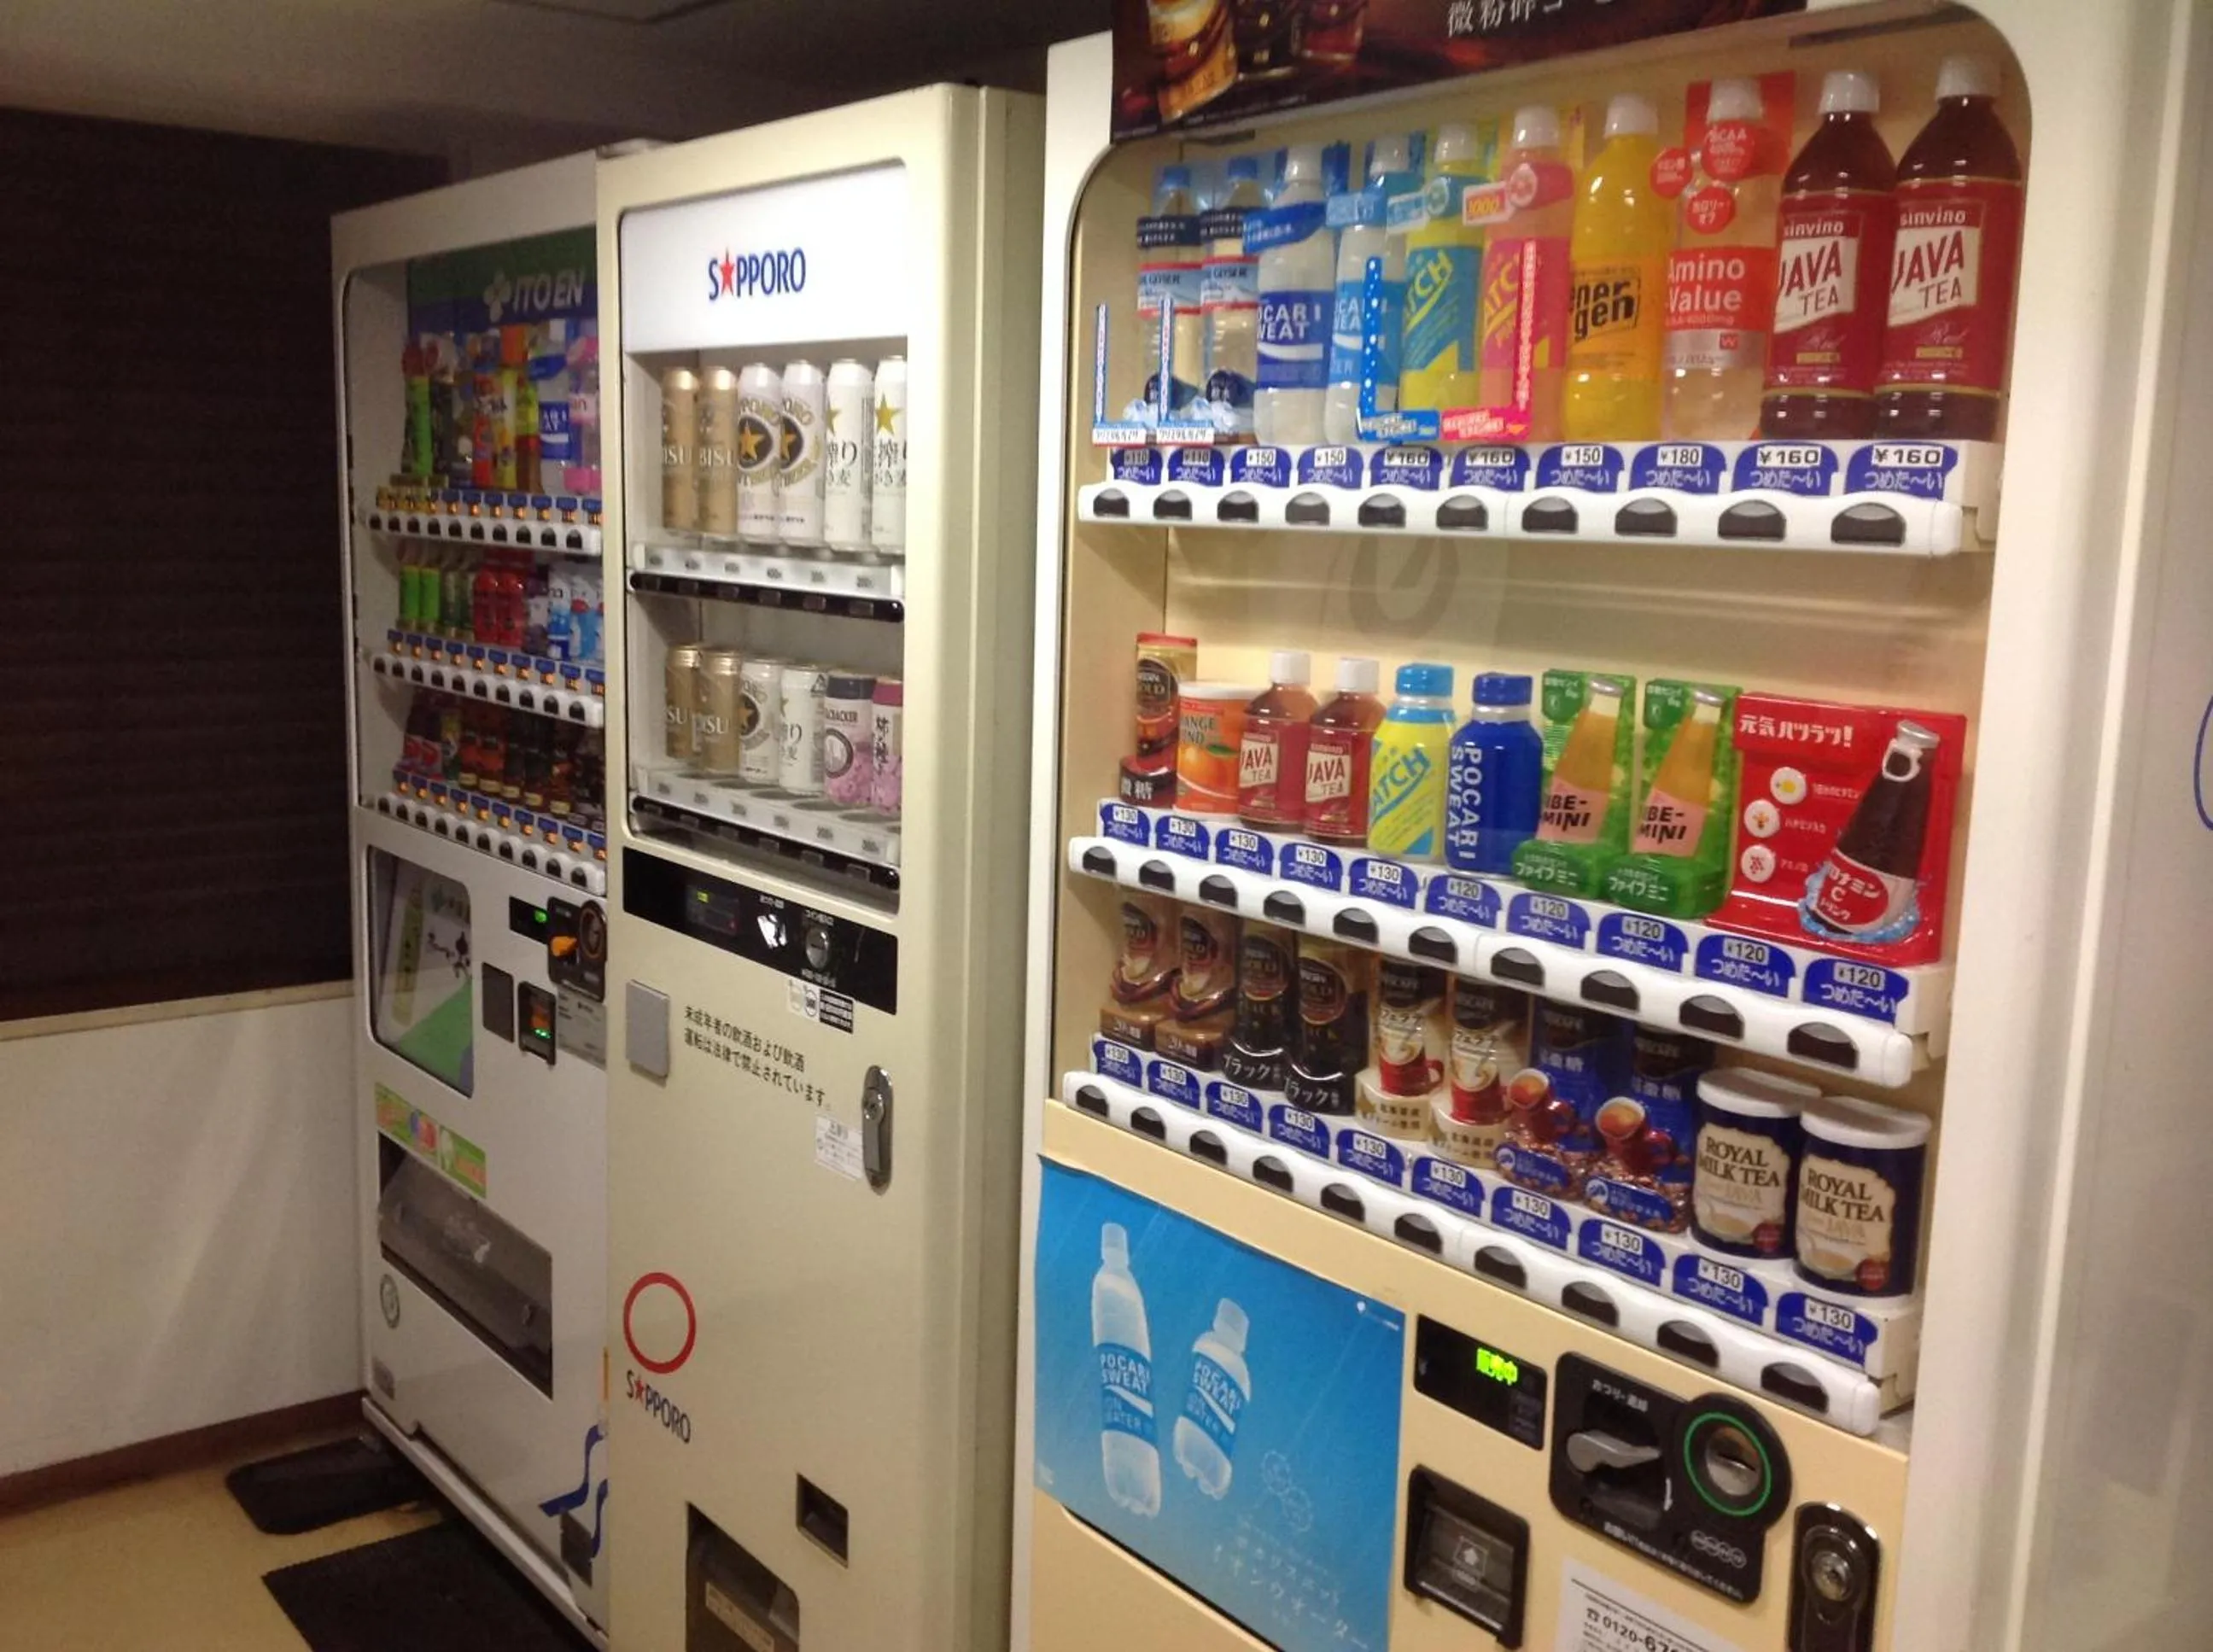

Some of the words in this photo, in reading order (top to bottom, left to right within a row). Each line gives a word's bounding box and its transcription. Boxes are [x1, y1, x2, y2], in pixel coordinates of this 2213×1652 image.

[1779, 240, 1842, 296] JAVA
[1890, 230, 1965, 294] JAVA
[1798, 285, 1838, 315] TEA
[1918, 277, 1962, 309] TEA
[1574, 295, 1635, 342] gen
[1564, 447, 1601, 464] ¥150
[1660, 447, 1700, 464] ¥180
[1759, 448, 1819, 464] ¥160
[1874, 448, 1941, 464] ¥160
[1739, 714, 1854, 748] 元気ハツラツ!
[1241, 745, 1273, 769] JAVA
[1252, 768, 1272, 782] TEA
[1309, 759, 1346, 785] JAVA
[1447, 745, 1465, 847] SWEAT
[1458, 746, 1483, 860] POCARI
[1831, 885, 1847, 902] C
[1706, 1135, 1770, 1168] ROYAL
[1740, 1168, 1780, 1188] TEA
[1808, 1168, 1873, 1201] ROYAL
[1842, 1200, 1885, 1223] TEA
